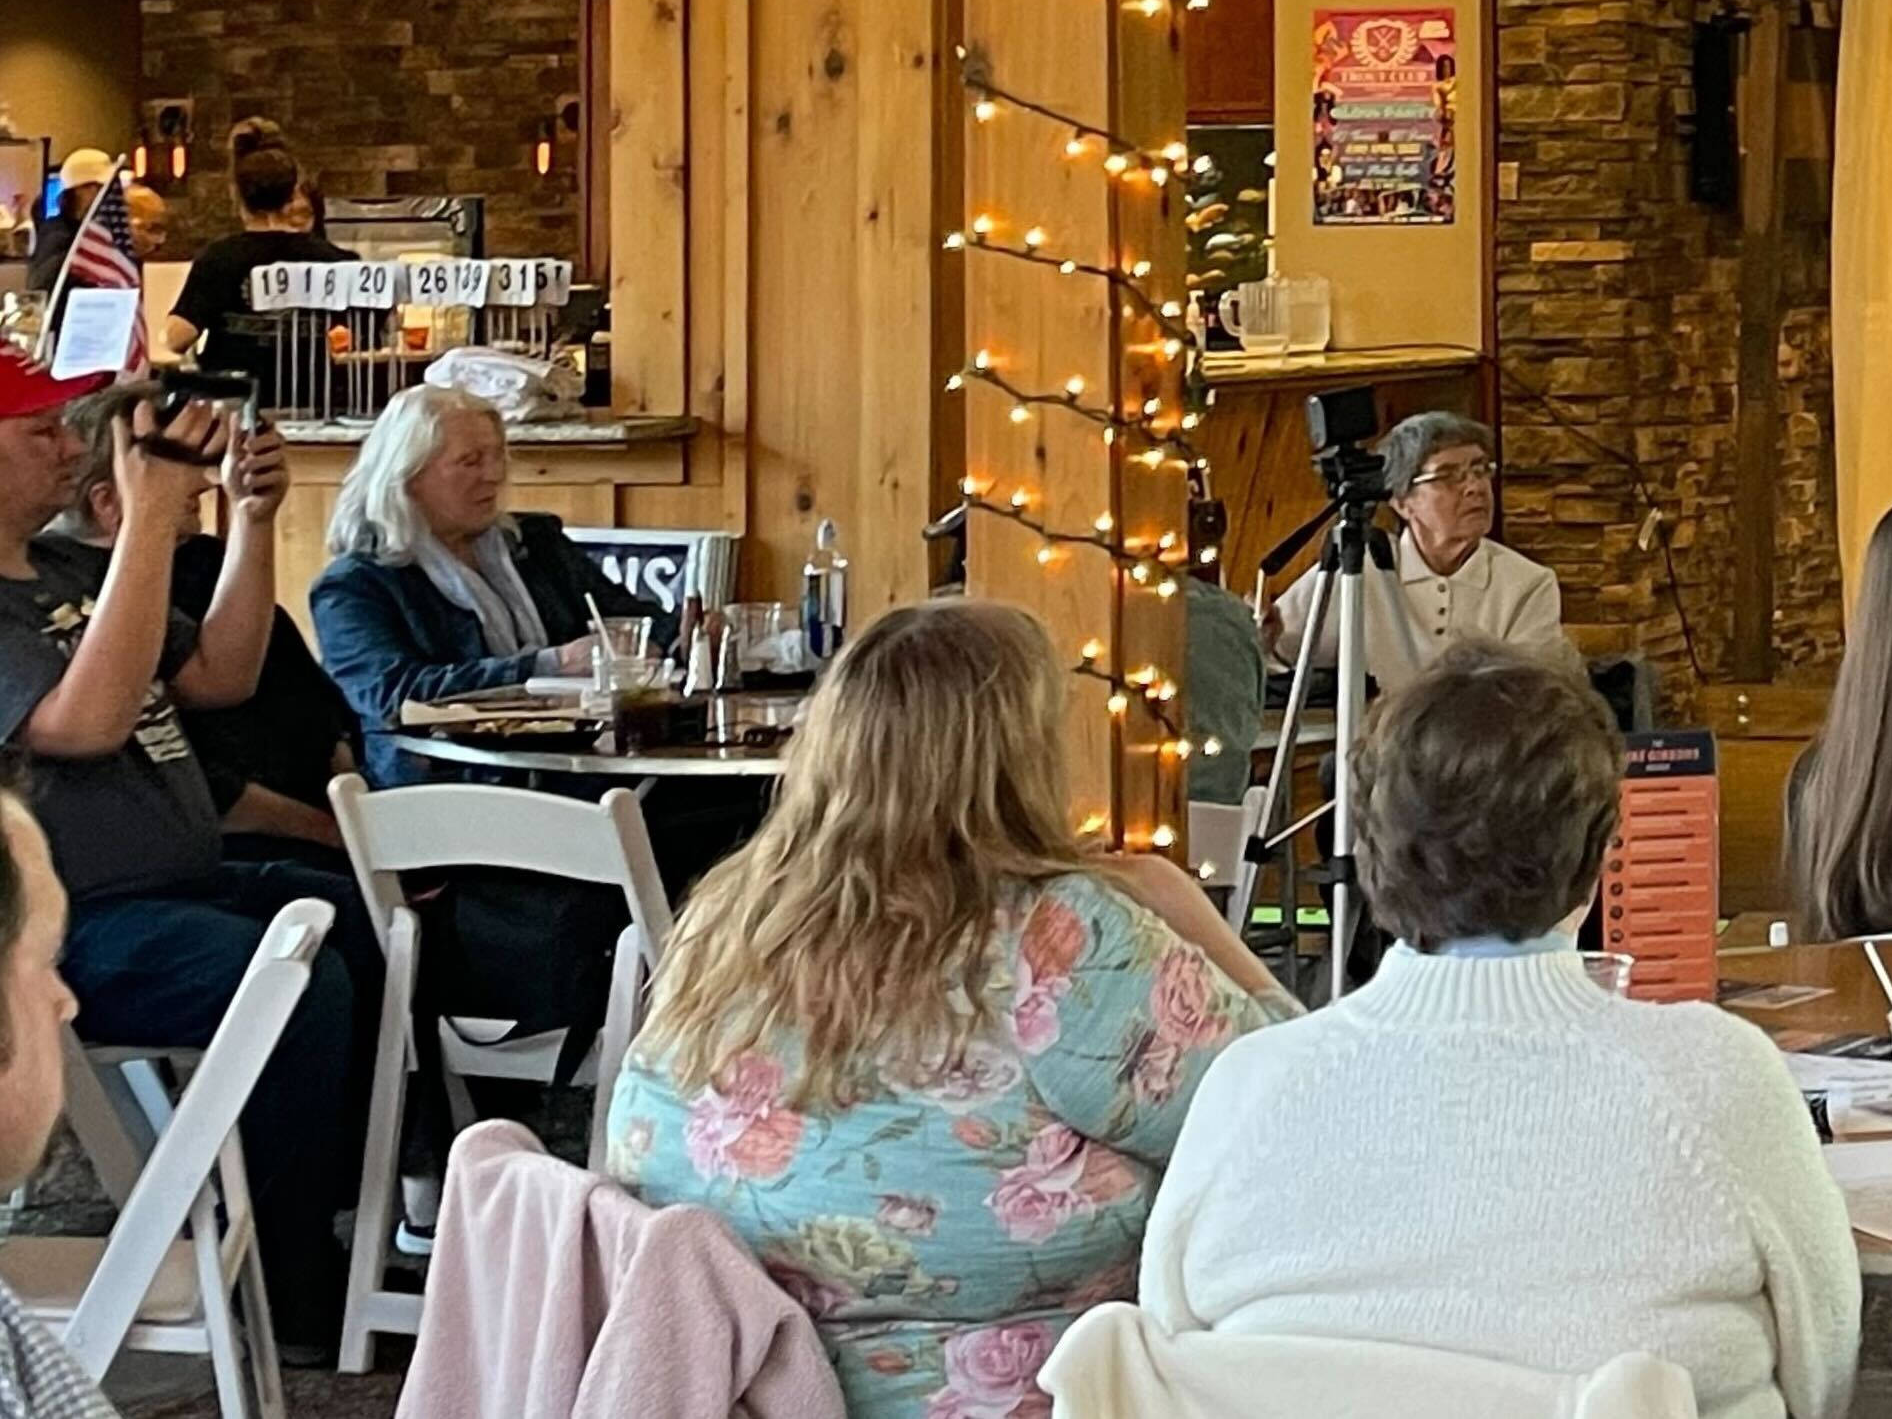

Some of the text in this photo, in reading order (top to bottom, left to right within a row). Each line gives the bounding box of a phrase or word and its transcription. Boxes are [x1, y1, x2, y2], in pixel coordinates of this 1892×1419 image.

[261, 267, 290, 296] 19
[359, 266, 386, 294] 20
[418, 265, 448, 294] 26
[498, 263, 527, 292] 31
